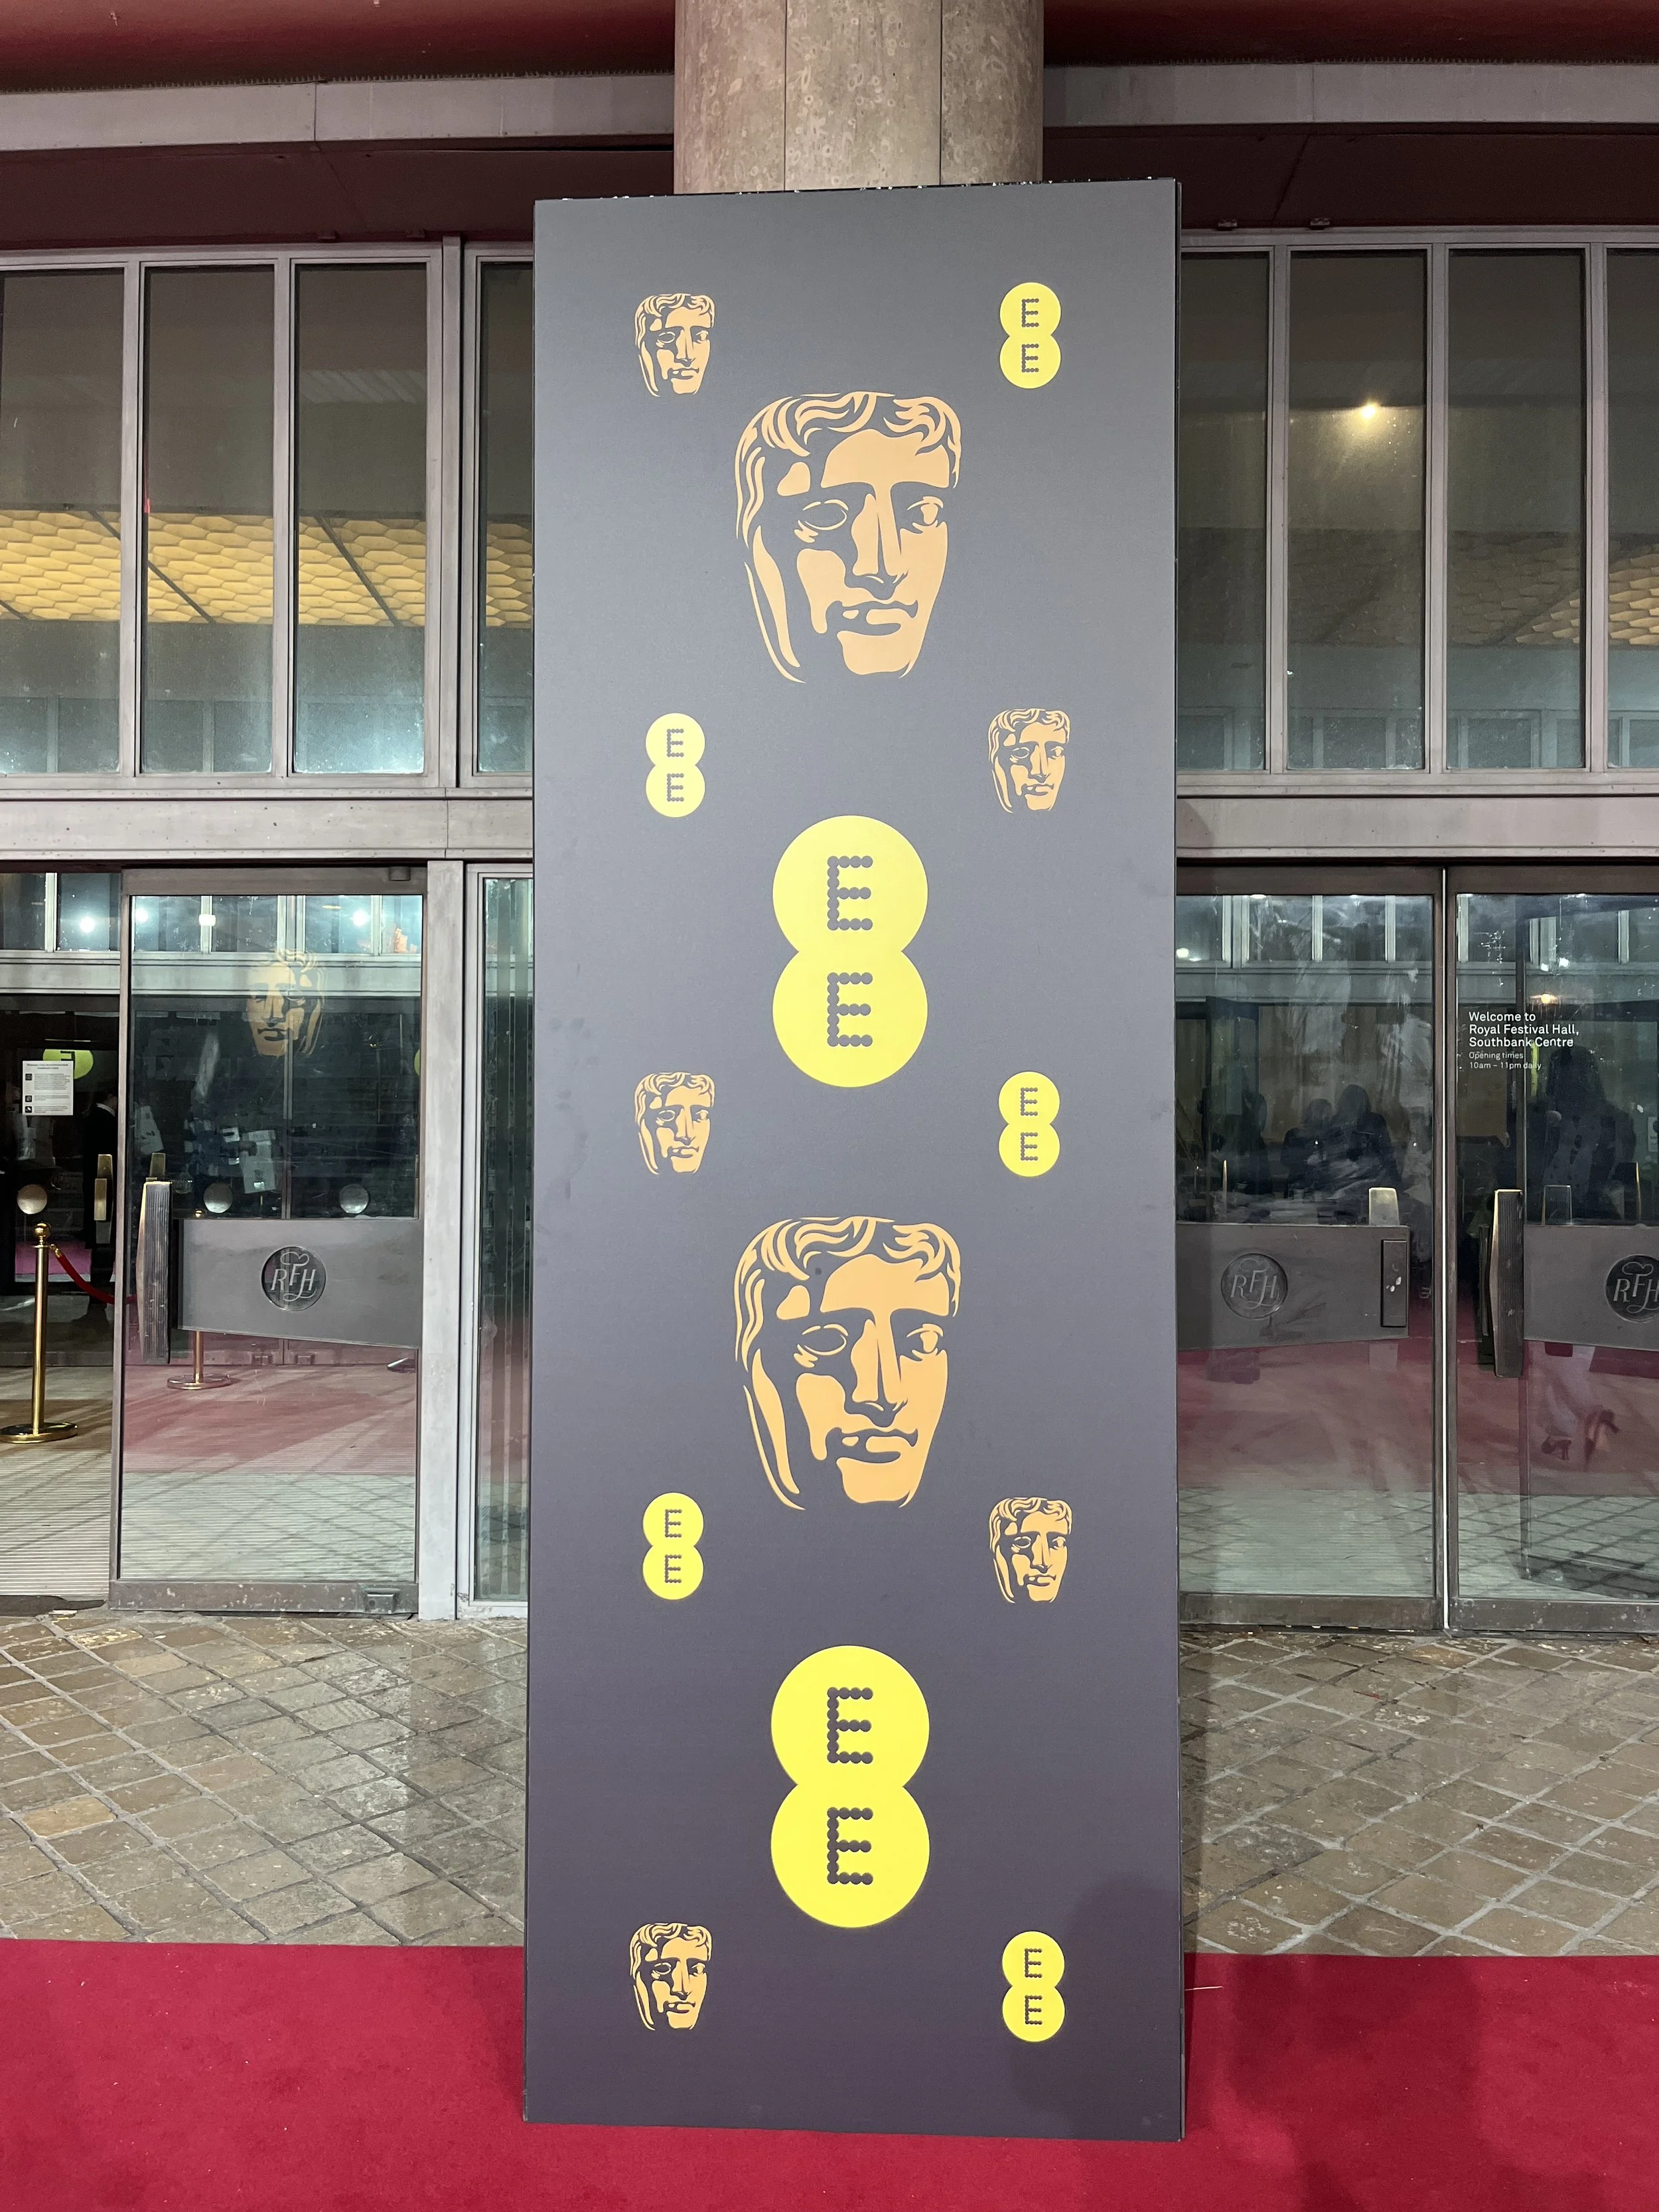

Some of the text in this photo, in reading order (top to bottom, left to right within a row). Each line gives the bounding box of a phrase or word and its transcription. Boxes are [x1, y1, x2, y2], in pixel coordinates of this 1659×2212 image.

[1469, 1011, 1536, 1021] Welcome to
[1469, 1023, 1579, 1037] Royal Festival Hall,
[1469, 1036, 1574, 1047] Southbank Centre
[1469, 1051, 1500, 1061] Opening
[1500, 1061, 1522, 1070] 11pm
[1523, 1061, 1542, 1070] daily
